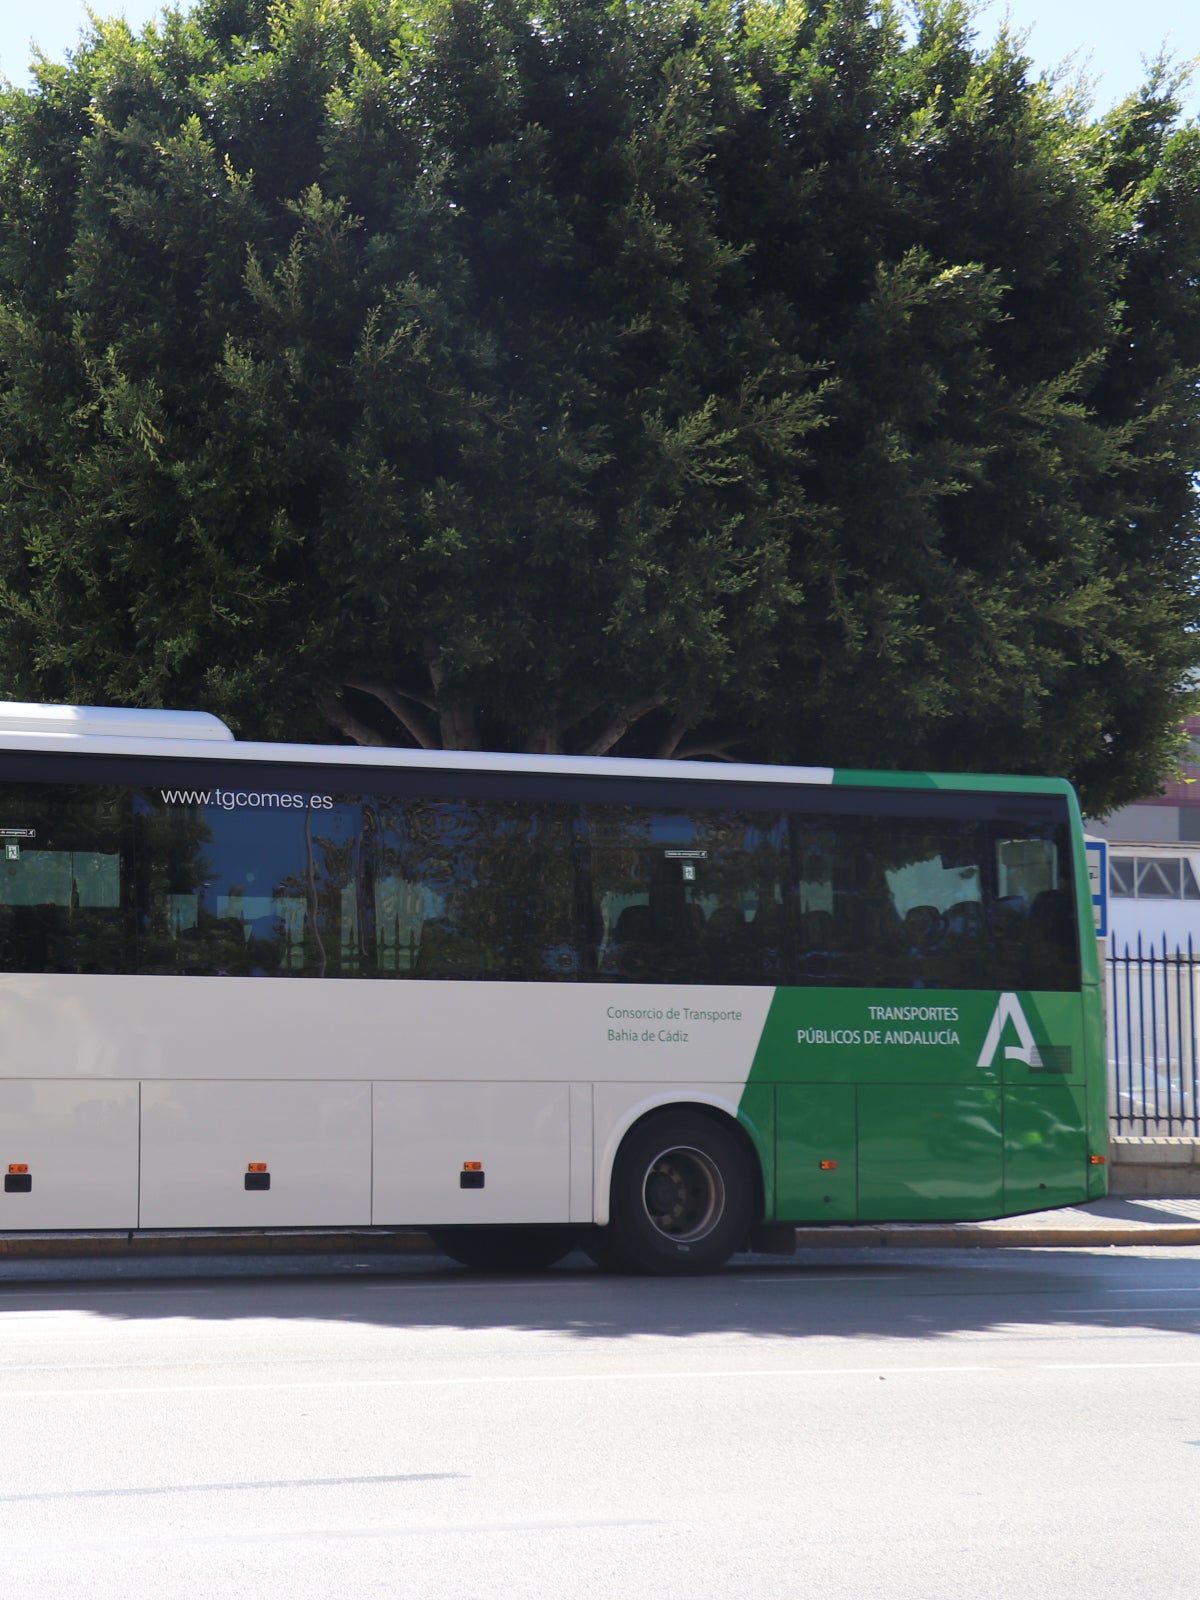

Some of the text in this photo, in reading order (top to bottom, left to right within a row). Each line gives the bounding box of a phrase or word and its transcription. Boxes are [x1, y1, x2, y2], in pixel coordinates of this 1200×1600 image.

[160, 788, 334, 810] www.tgcomes.es
[606, 1006, 742, 1023] Consorcio de Transporte
[868, 1006, 959, 1021] TRANSPORTES
[641, 1029, 655, 1041] de
[658, 1029, 689, 1042] Cádiz
[797, 1027, 960, 1045] PÚBLICOS DE ANDALUCÍA
